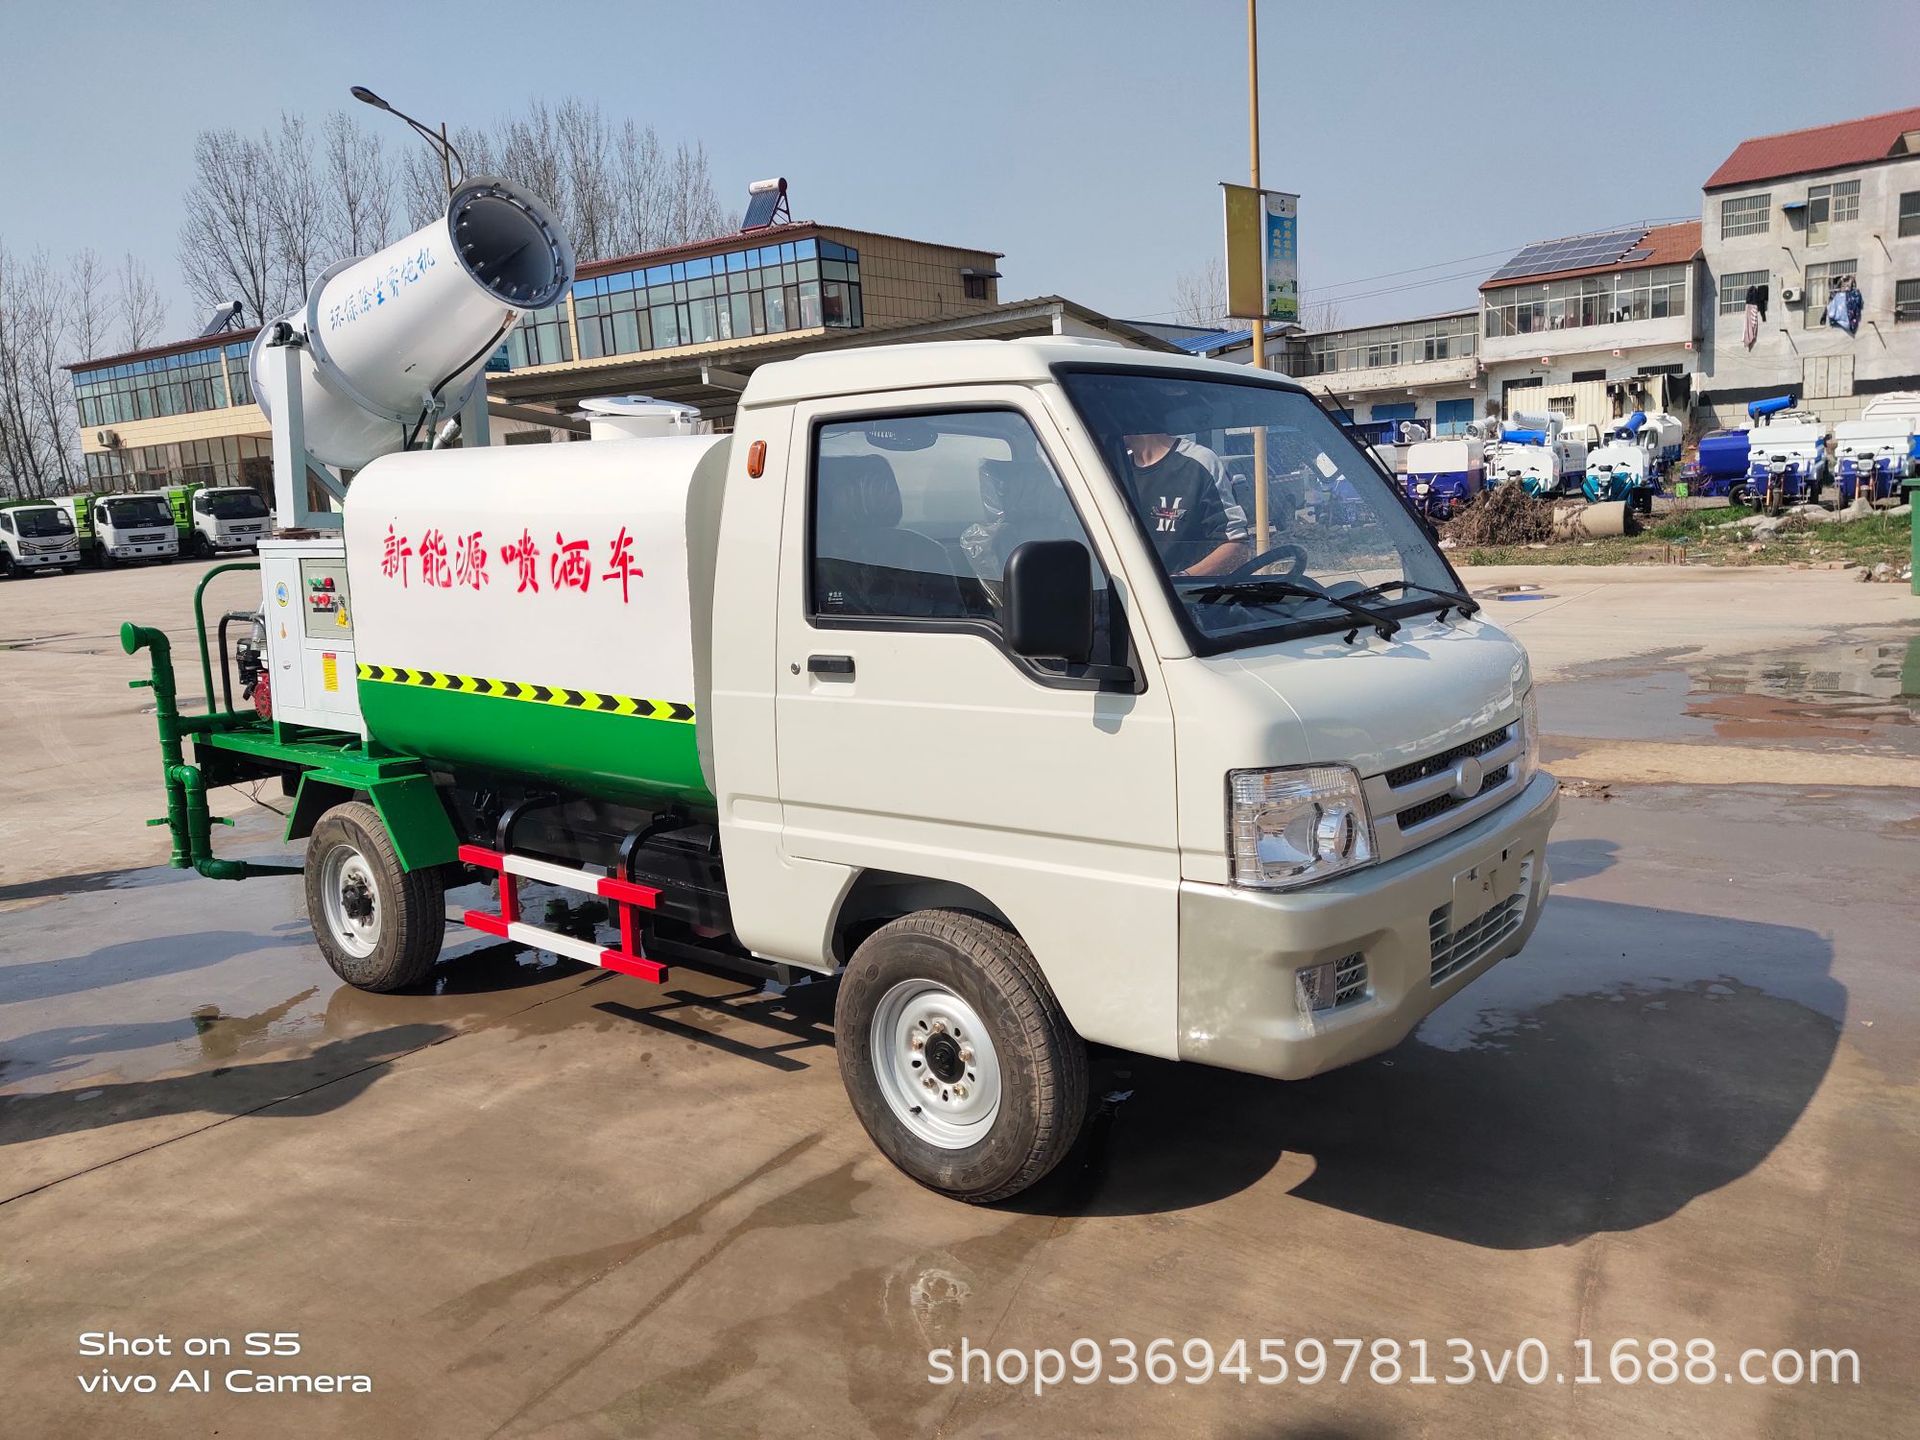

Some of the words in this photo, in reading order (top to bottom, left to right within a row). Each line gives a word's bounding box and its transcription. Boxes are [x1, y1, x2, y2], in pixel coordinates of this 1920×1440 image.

[381, 523, 644, 604] 新能源喷洒车
